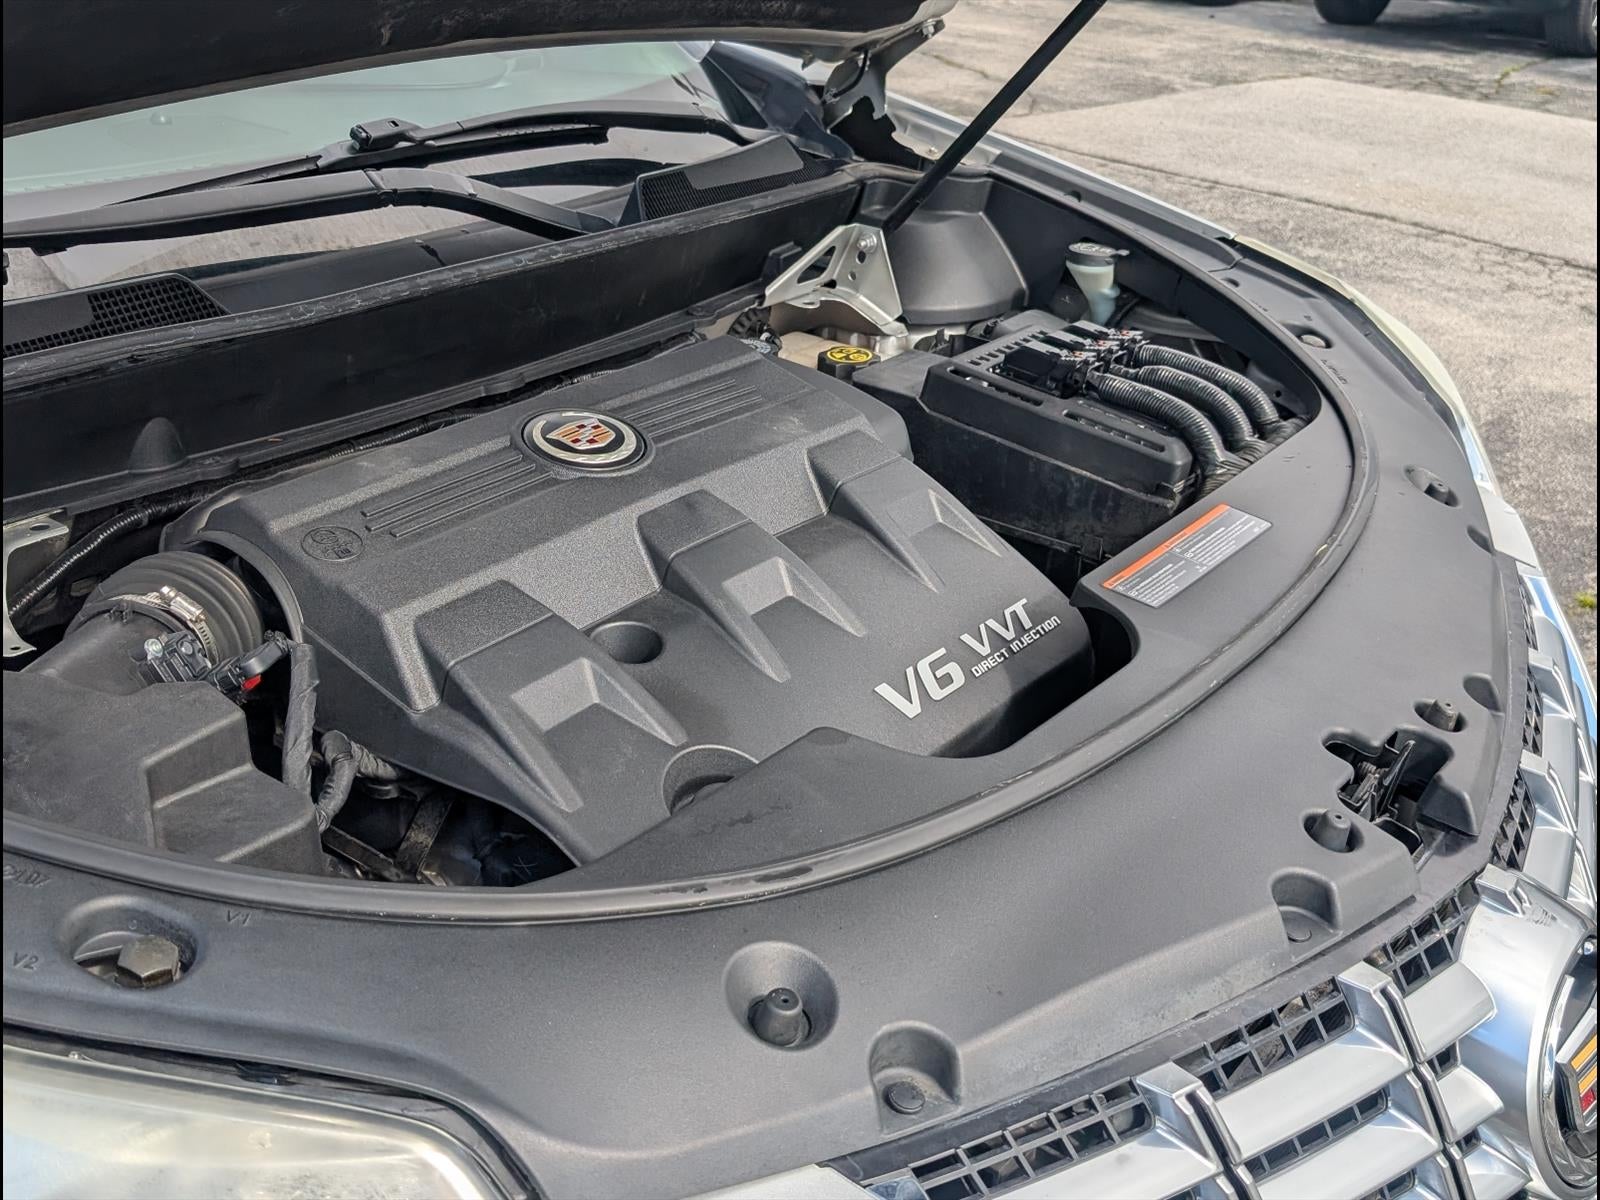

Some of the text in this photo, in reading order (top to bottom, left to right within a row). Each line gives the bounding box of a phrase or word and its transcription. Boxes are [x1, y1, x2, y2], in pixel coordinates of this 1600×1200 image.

[874, 598, 1033, 719] V6 VVT
[970, 615, 1061, 677] DIRECT INJECTION
[13, 952, 39, 970] V2
